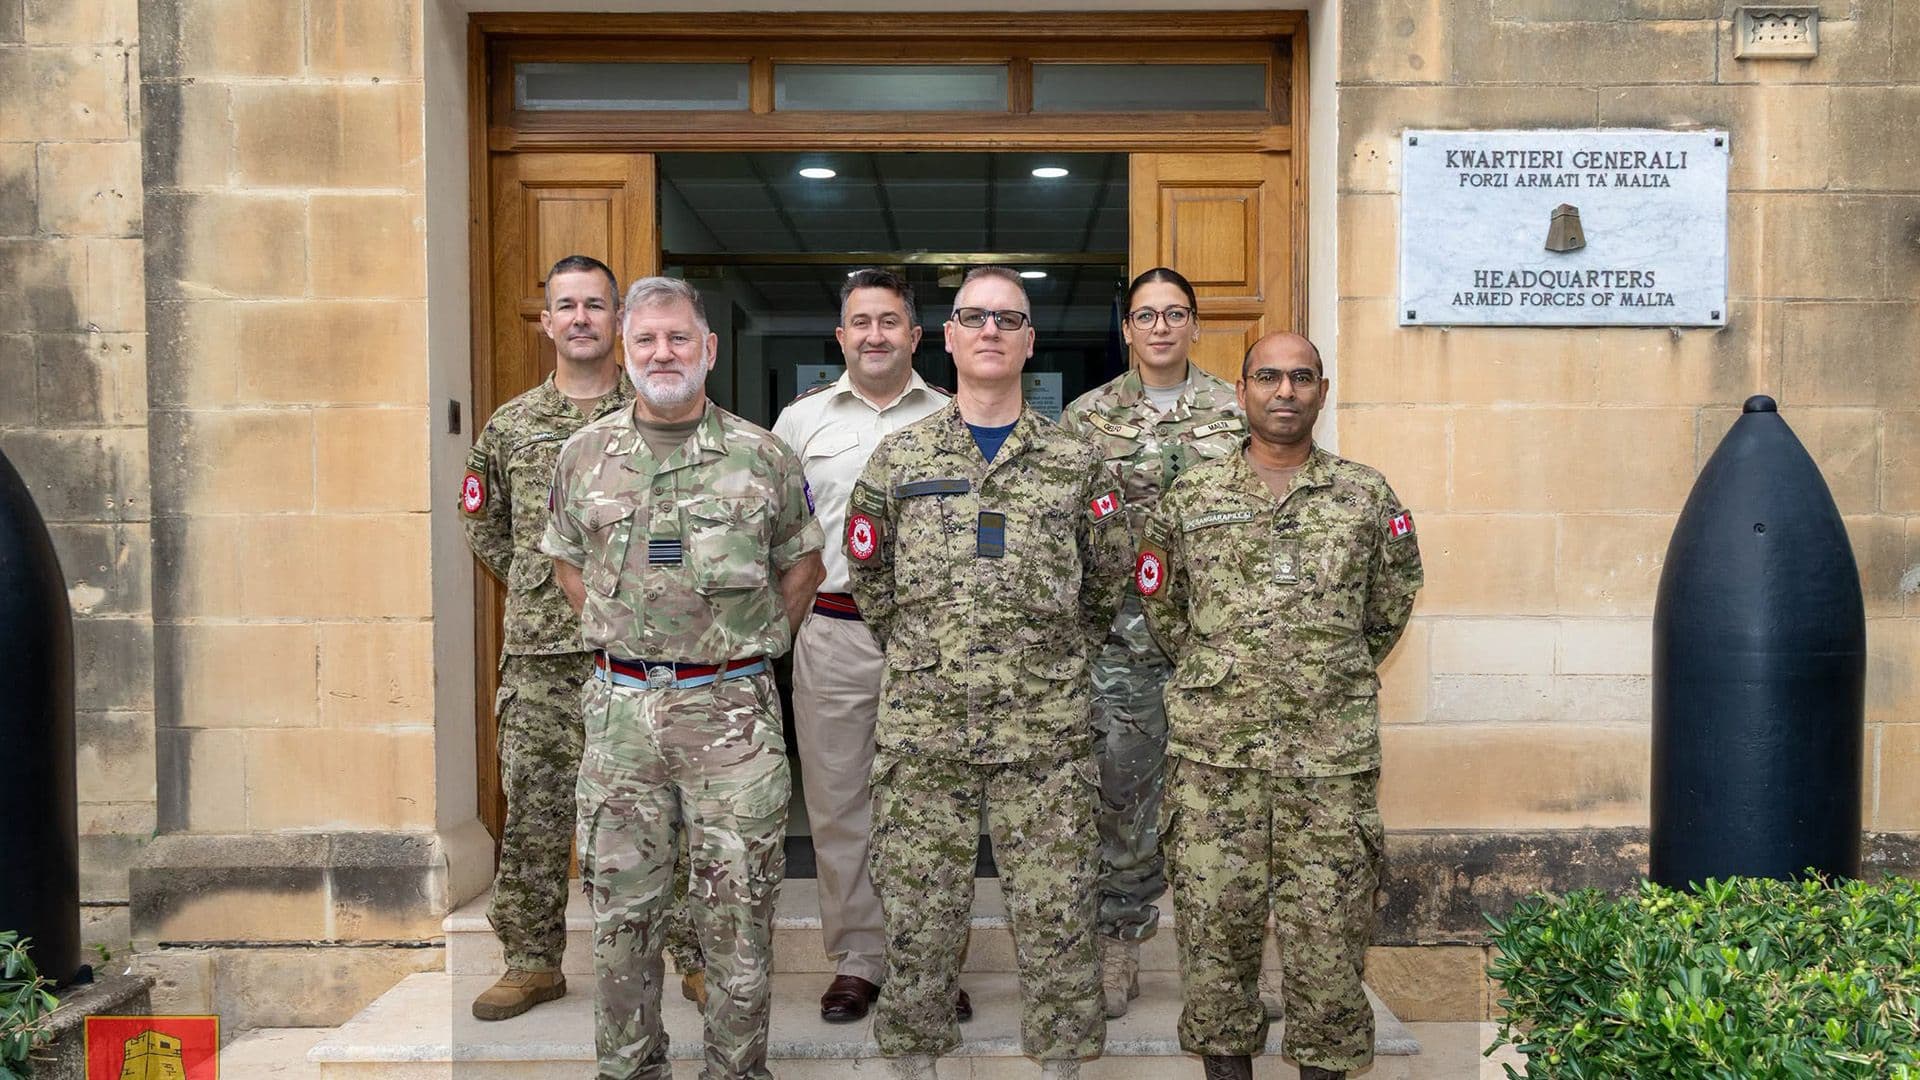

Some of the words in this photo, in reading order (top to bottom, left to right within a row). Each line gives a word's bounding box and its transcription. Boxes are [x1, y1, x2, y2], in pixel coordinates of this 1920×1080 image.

[1445, 150, 1562, 169] KWARTIERI
[1459, 173, 1508, 188] FORZI
[1514, 173, 1580, 188] ARMATI
[1614, 173, 1672, 188] MALTA
[1473, 269, 1656, 289] HEADQUARTERS
[1451, 291, 1513, 306] ARMED
[1520, 292, 1585, 306] FORCES
[1591, 292, 1615, 306] OF
[1620, 292, 1676, 306] MALTA
[1207, 421, 1229, 430] MALTA
